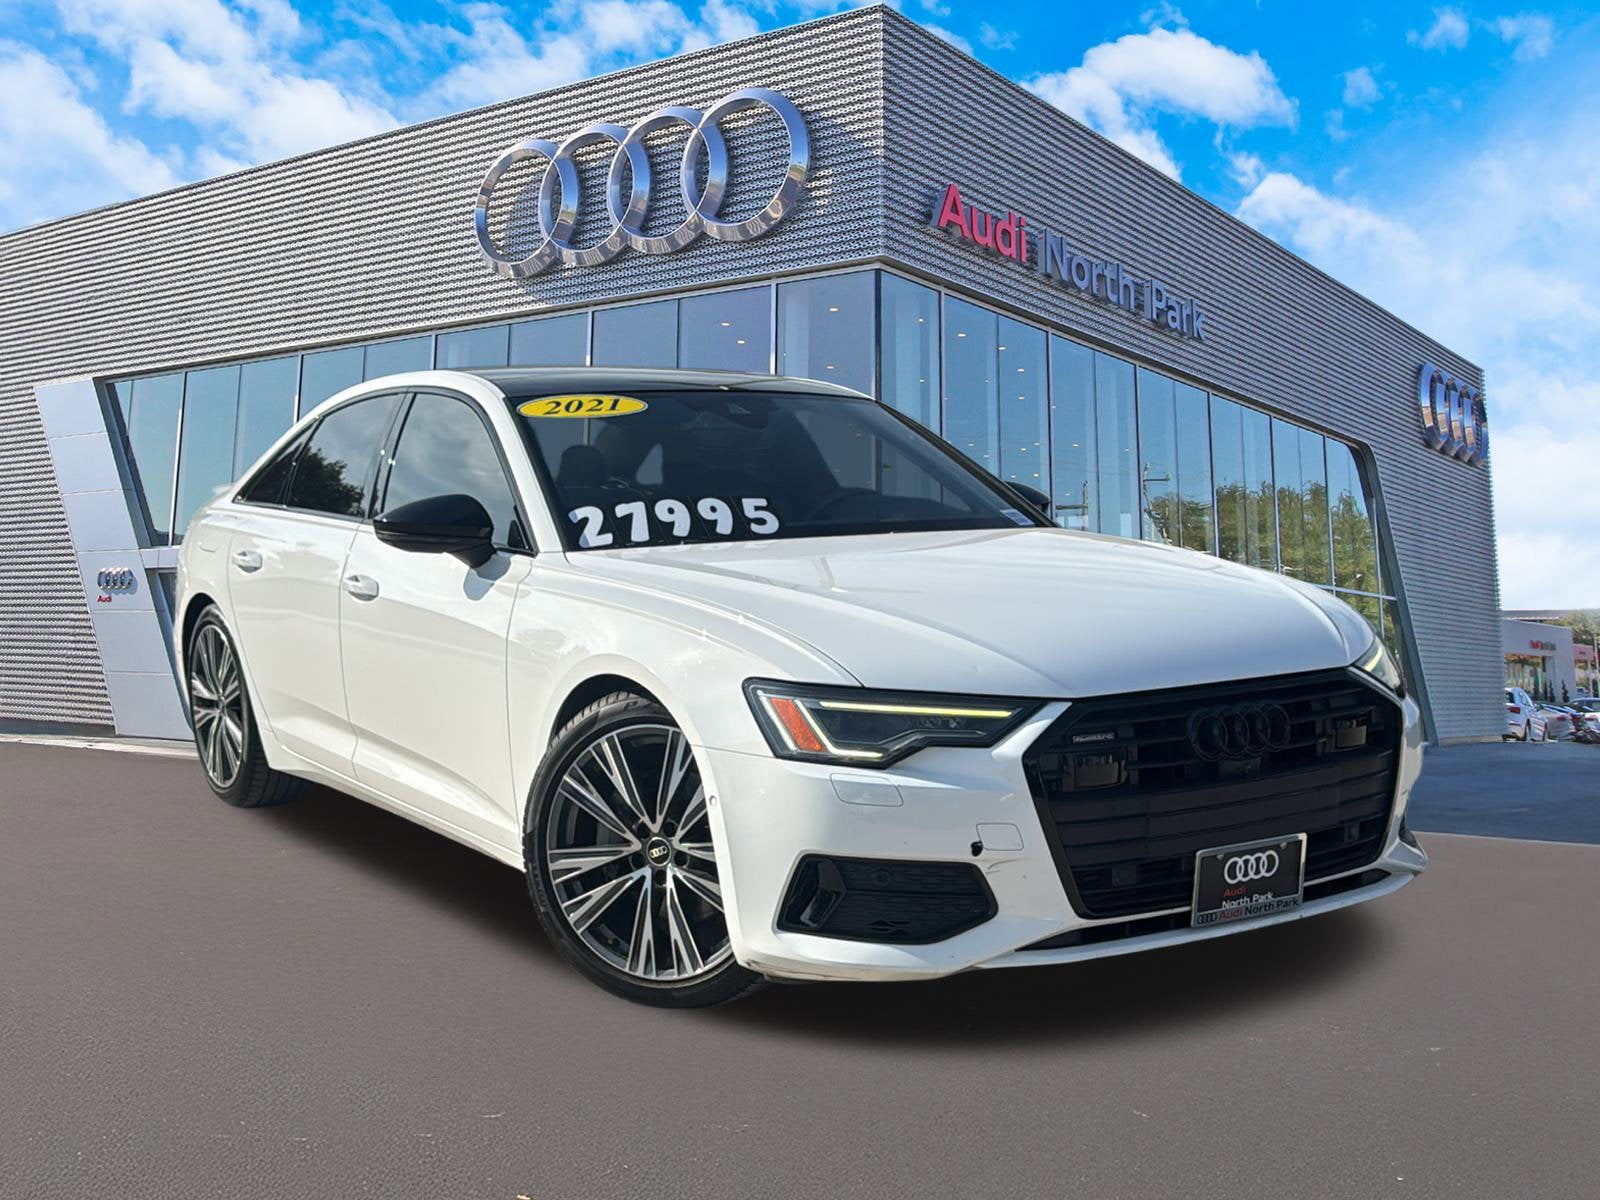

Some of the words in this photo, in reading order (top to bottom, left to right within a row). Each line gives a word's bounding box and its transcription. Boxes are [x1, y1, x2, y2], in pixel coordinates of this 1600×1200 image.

[932, 183, 1028, 263] Audi
[1038, 229, 1136, 310] North
[1144, 279, 1206, 340] Park
[543, 398, 621, 416] 2021
[568, 497, 780, 549] 27995
[97, 595, 112, 603] Audi
[1222, 896, 1250, 909] North
[1252, 892, 1273, 904] Park
[1223, 886, 1247, 897] Audi
[1219, 907, 1243, 921] Audi
[1244, 902, 1275, 915] North
[1276, 899, 1298, 910] Park
